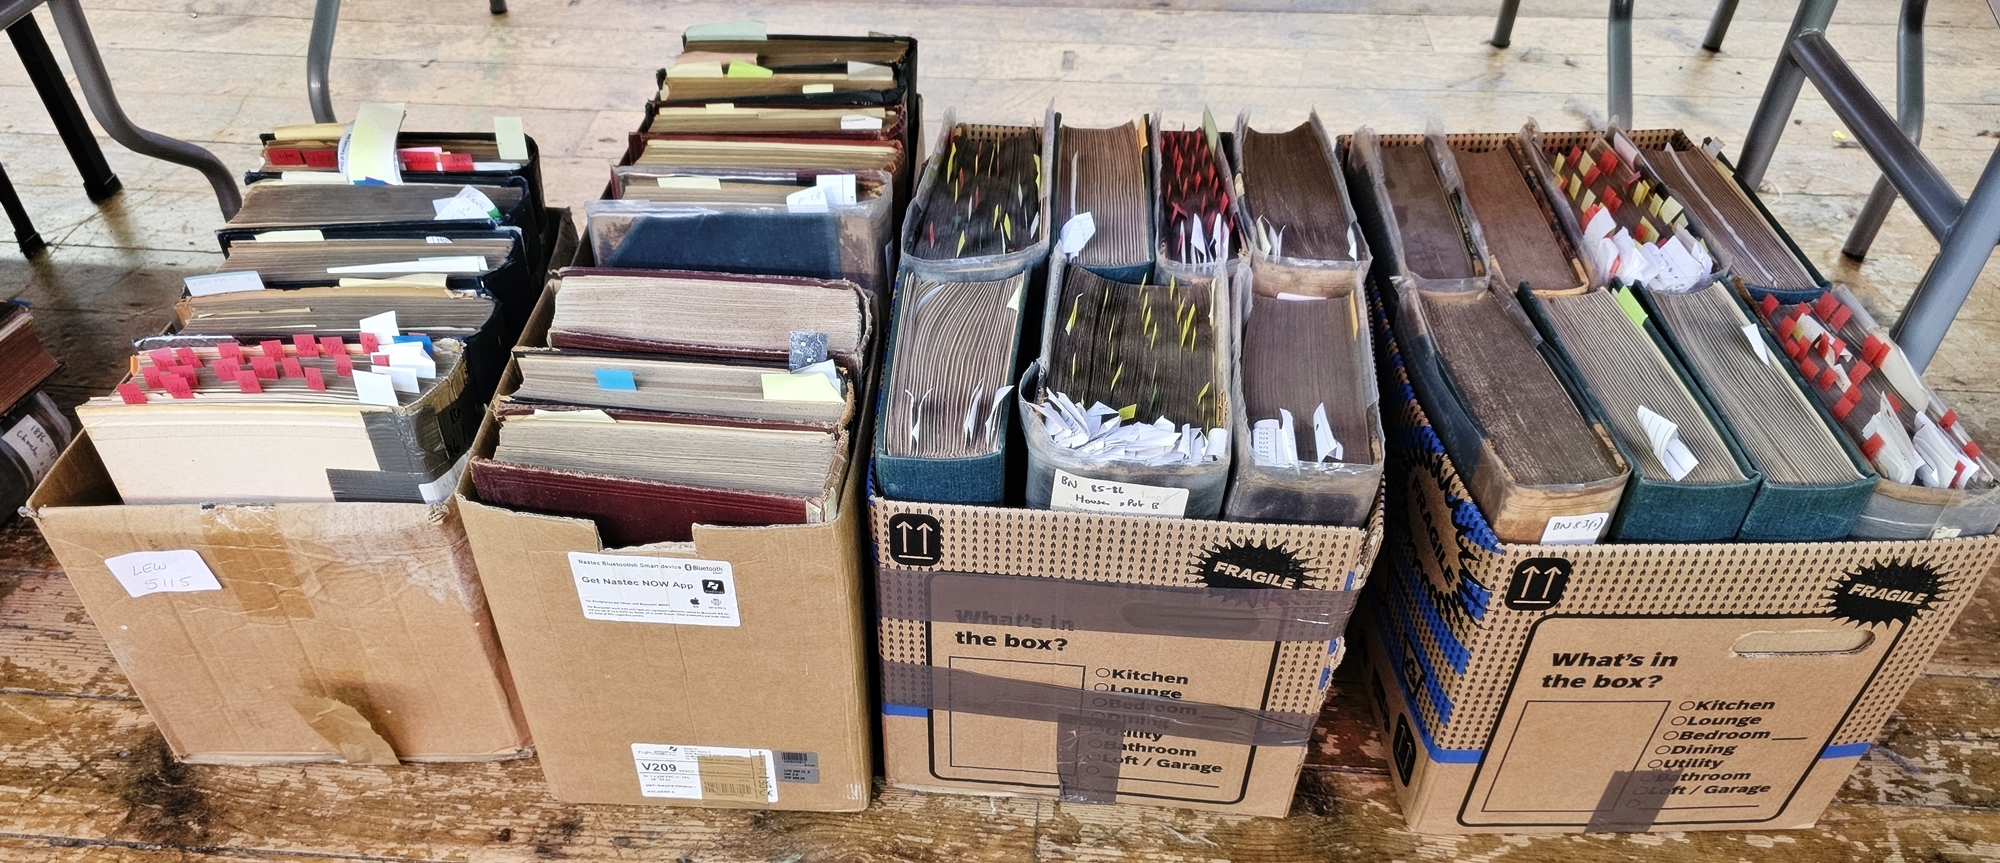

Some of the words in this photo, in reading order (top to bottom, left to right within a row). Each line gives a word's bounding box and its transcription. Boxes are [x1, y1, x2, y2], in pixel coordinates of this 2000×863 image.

[1061, 476, 1078, 489] BN
[1412, 475, 1454, 584] FRAGILE
[1553, 521, 1572, 531] BN
[132, 561, 167, 576] LEW
[1213, 561, 1297, 589] FRAGILE
[581, 576, 601, 585] Get
[602, 577, 640, 587] Nastec
[642, 580, 670, 588] NOW
[672, 581, 694, 590] App
[1848, 583, 1928, 605] FRAGILE
[1050, 614, 1075, 631] in
[955, 631, 997, 646] the
[1004, 633, 1068, 651] box?
[1552, 652, 1645, 667] What's
[1650, 651, 1679, 667] in
[1112, 669, 1189, 685] Kitchen
[1541, 674, 1586, 688] the
[1592, 674, 1664, 688] box?
[1110, 684, 1183, 699] Lounge
[1695, 700, 1776, 711] Kitchen
[1686, 716, 1762, 727] Lounge
[1678, 730, 1771, 740] Bedroom
[1670, 744, 1739, 756] Dining
[641, 762, 677, 772] V209
[1156, 759, 1223, 774] Garage
[1663, 758, 1725, 770] Utility
[1703, 785, 1771, 795] Garage
